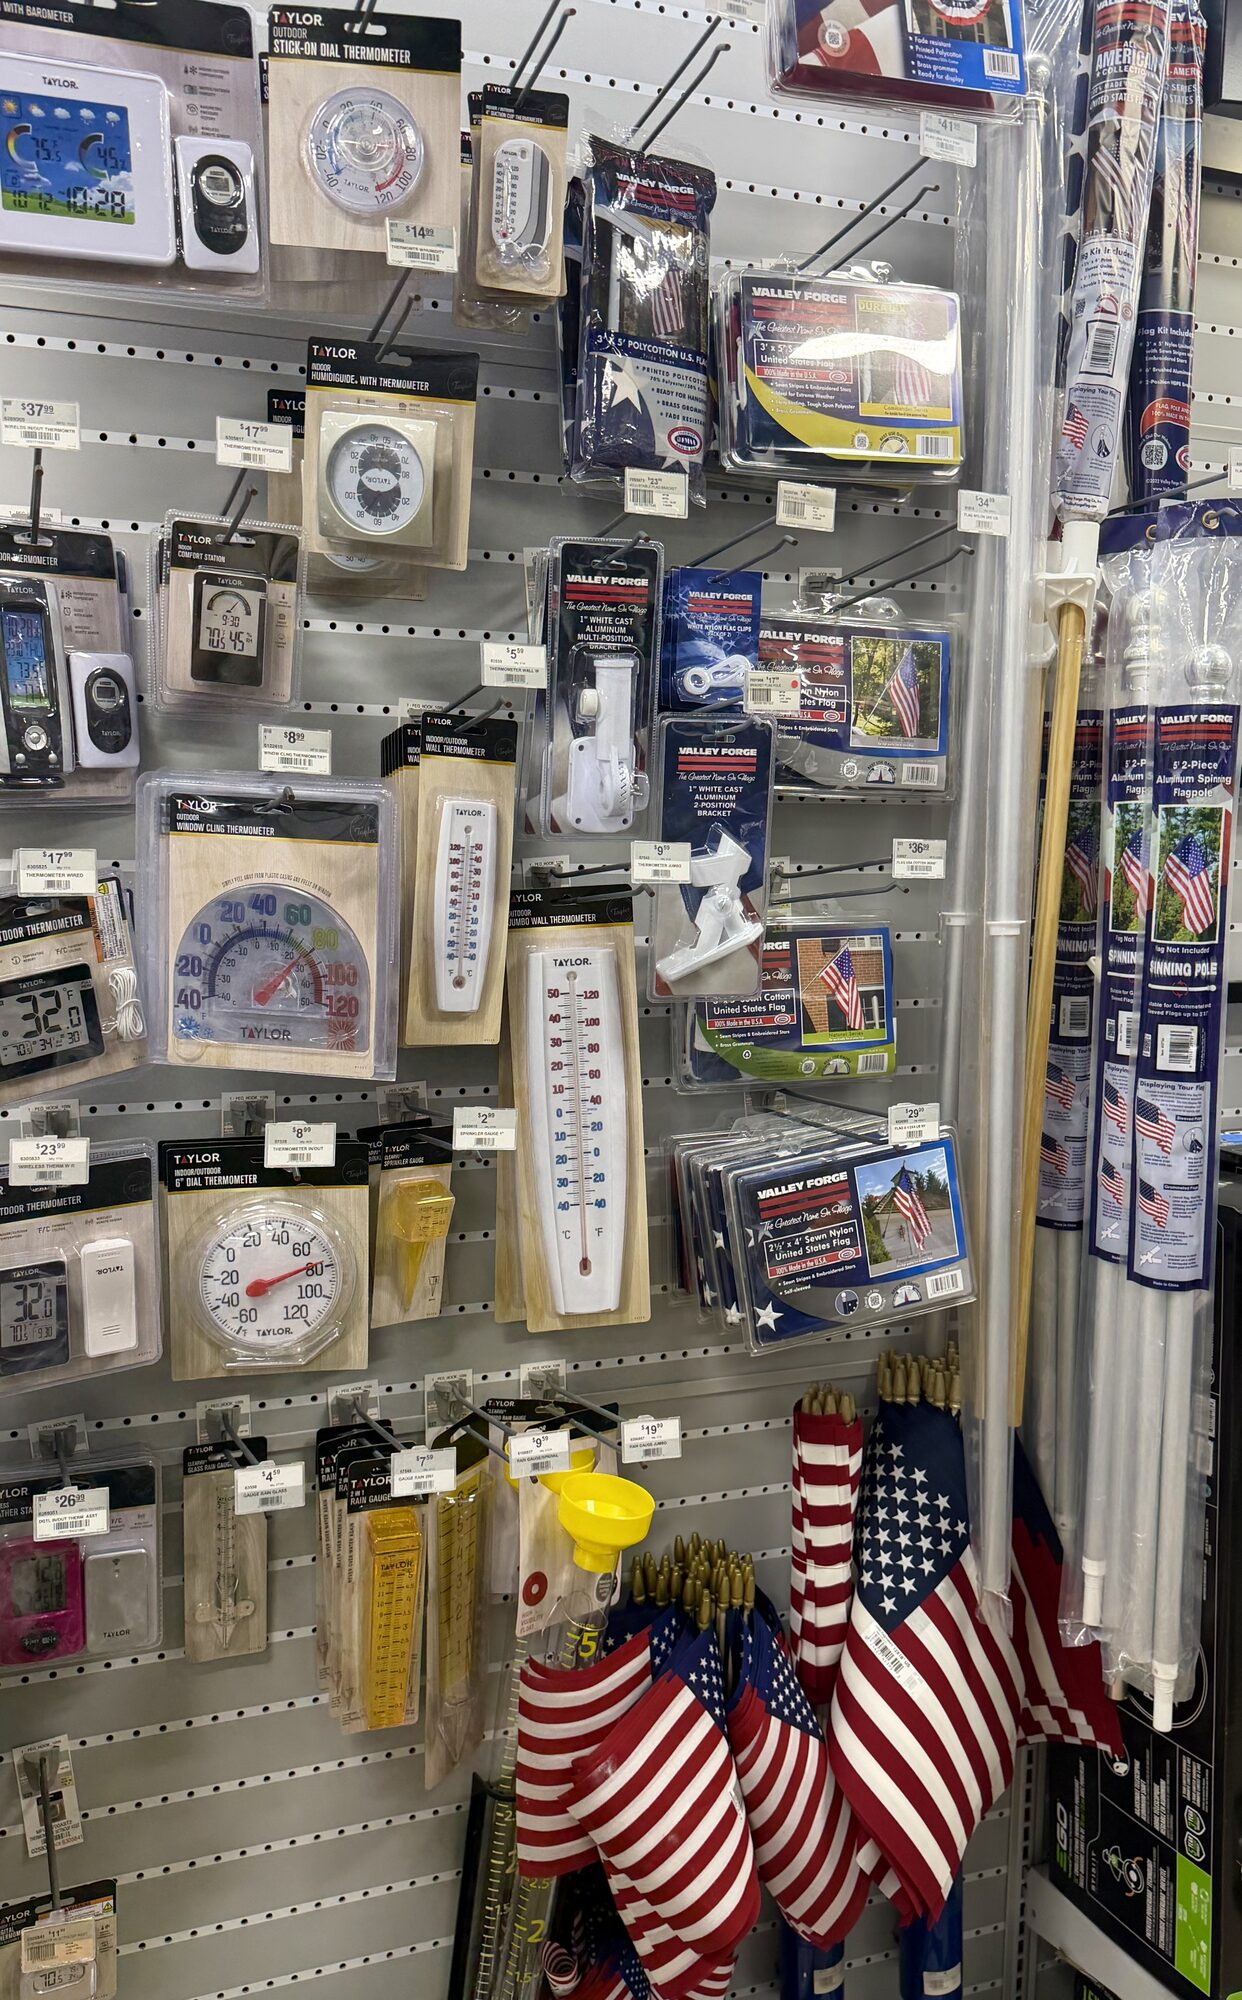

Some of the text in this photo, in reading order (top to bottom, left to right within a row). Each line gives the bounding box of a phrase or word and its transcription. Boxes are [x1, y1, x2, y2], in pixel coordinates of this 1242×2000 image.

[3, 2, 74, 24] WITH BAROMETER
[272, 11, 324, 27] TAYLOR
[273, 26, 307, 39] OUTDOOR
[930, 39, 951, 47] resistant
[273, 39, 411, 64] STICK-ON DIAL THERMOMETER
[916, 46, 962, 58] Printed Polycotton
[917, 61, 958, 73] Brass grommets
[918, 69, 935, 79] Ready
[945, 73, 964, 84] display
[42, 76, 79, 90] TAYLOR
[487, 85, 511, 95] TAYLOR
[515, 113, 543, 124] THERMOMETER
[616, 172, 694, 194] VALLEY FORGE
[374, 191, 394, 204] 120
[752, 287, 847, 304] VALLEY FORGE
[312, 345, 357, 360] TAYLOR
[618, 338, 626, 347] 5'
[628, 340, 678, 359] POLYCOTTON
[680, 350, 695, 362] U.S.
[761, 355, 788, 365] United
[311, 363, 331, 371] INDOOR
[642, 366, 670, 377] PRINTED
[360, 376, 377, 386] WITH
[379, 377, 430, 391] THERMOMETER
[656, 387, 686, 399] READY FOR
[662, 400, 680, 410] BRASS
[665, 412, 679, 421] FADE
[178, 533, 212, 545] TAYLOR
[178, 550, 226, 564] COMFORT STATION
[217, 577, 244, 587] TAYLOR
[566, 575, 649, 587] VALLEY FORGE
[6, 585, 35, 595] TAYLOR
[688, 590, 752, 601] VALLEY FORGE
[222, 615, 240, 628] 9:30
[589, 616, 609, 625] WHITE
[611, 617, 634, 625] CAST
[586, 625, 626, 634] ALUMINUM
[688, 623, 752, 632] WHITE NYLON FLAG CLIPS
[577, 633, 634, 643] MULTI-POSITION
[804, 632, 844, 645] FORGE
[814, 687, 839, 698] Nylon
[818, 697, 836, 709] Flag
[427, 717, 453, 726] TAYLOR
[1116, 715, 1146, 725] VALLEY
[1161, 714, 1233, 725] VALLEY FORGE
[426, 735, 468, 746] INDOOR/OUTDOOR
[426, 743, 486, 757] WALL THERMOMETER
[678, 747, 757, 756] VALLEY FORGE
[1181, 760, 1219, 770] 2-Piece
[694, 793, 736, 801] ALUMINUM
[1174, 787, 1212, 799] Flagpole
[176, 799, 217, 811] TAYLOR
[694, 801, 736, 809] 2-POSITION
[176, 813, 199, 821] OUTDOOR
[456, 808, 483, 817] TAYLOR
[176, 822, 275, 836] WINDOW CLING THERMOMETER
[251, 893, 277, 916] 40
[220, 901, 245, 924] 20
[531, 915, 548, 925] WALL
[550, 913, 596, 923] THERMOMETER
[25, 915, 84, 936] THERMOMETER
[553, 958, 589, 967] TAYLOR
[19, 979, 46, 989] TAYLOR
[547, 988, 560, 1000] 50
[583, 990, 600, 1000] 120
[764, 993, 791, 1001] Cotton
[713, 1003, 786, 1015] United States Flag
[240, 1025, 291, 1042] TAYLOR
[1140, 1080, 1194, 1091] Displaying Your
[174, 1152, 220, 1165] TAYLOR
[174, 1166, 221, 1177] INDOOR/OUTDOOR
[186, 1176, 203, 1187] DIAL
[205, 1174, 258, 1186] THERMOMETER
[757, 1172, 848, 1200] VALLEY FORGE
[26, 1195, 82, 1213] THERMOMETER
[761, 1204, 852, 1231] The Greatest Name In Flags
[271, 1230, 290, 1245] 40
[804, 1233, 827, 1244] Sewn
[829, 1226, 854, 1238] Nylon
[292, 1242, 311, 1257] 60
[775, 1238, 850, 1261] United States Flag
[297, 1284, 323, 1300] 100
[283, 1305, 309, 1321] 120
[257, 1328, 291, 1337] TAYLOR
[188, 1445, 214, 1454] TAYLOR
[350, 1493, 392, 1505] RAIN GAUGE
[381, 1559, 414, 1569] TAYLOR
[103, 1629, 131, 1639] TAYLOR
[578, 1631, 599, 1657] 5
[1057, 1800, 1068, 1872] EGO
[527, 1920, 546, 1943] 2
